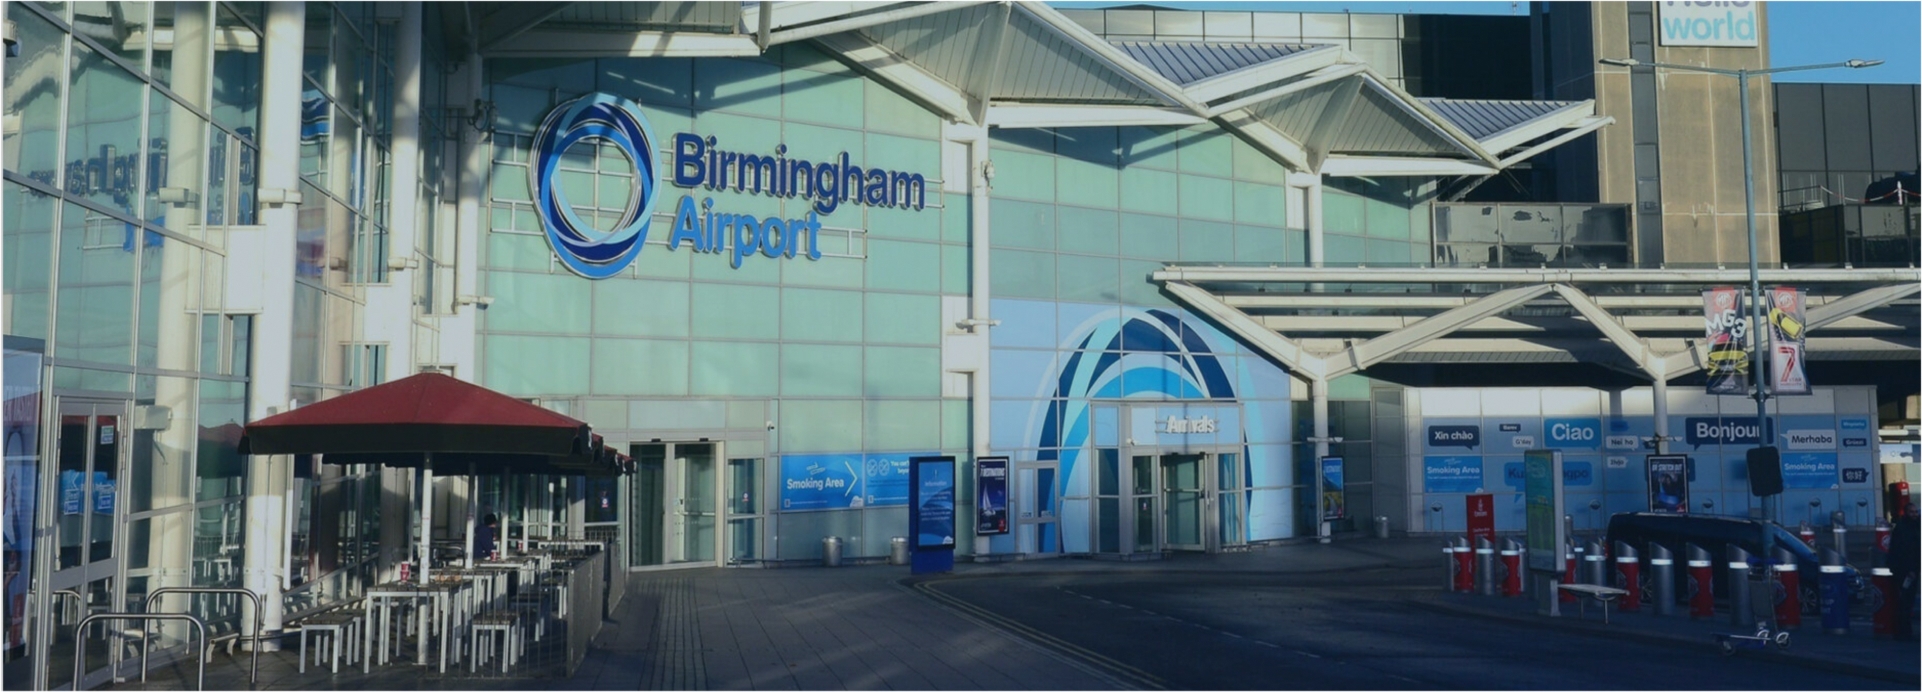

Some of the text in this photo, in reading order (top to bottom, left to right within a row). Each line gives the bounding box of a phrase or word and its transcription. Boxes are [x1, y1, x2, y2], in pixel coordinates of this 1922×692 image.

[1663, 11, 1755, 40] world
[672, 132, 925, 215] Birmingham
[668, 194, 822, 269] Airport
[1705, 309, 1747, 338] MG3
[1778, 346, 1795, 382] 7
[1167, 415, 1215, 433] Arrivals
[1552, 423, 1594, 441] Ciao
[1434, 431, 1474, 440] Xin chào
[1515, 438, 1532, 446] G'day
[1791, 434, 1833, 444] Merhaba
[1427, 466, 1460, 475] Smoking
[1784, 463, 1817, 471] Smoking
[787, 477, 845, 491] Smoking Area
